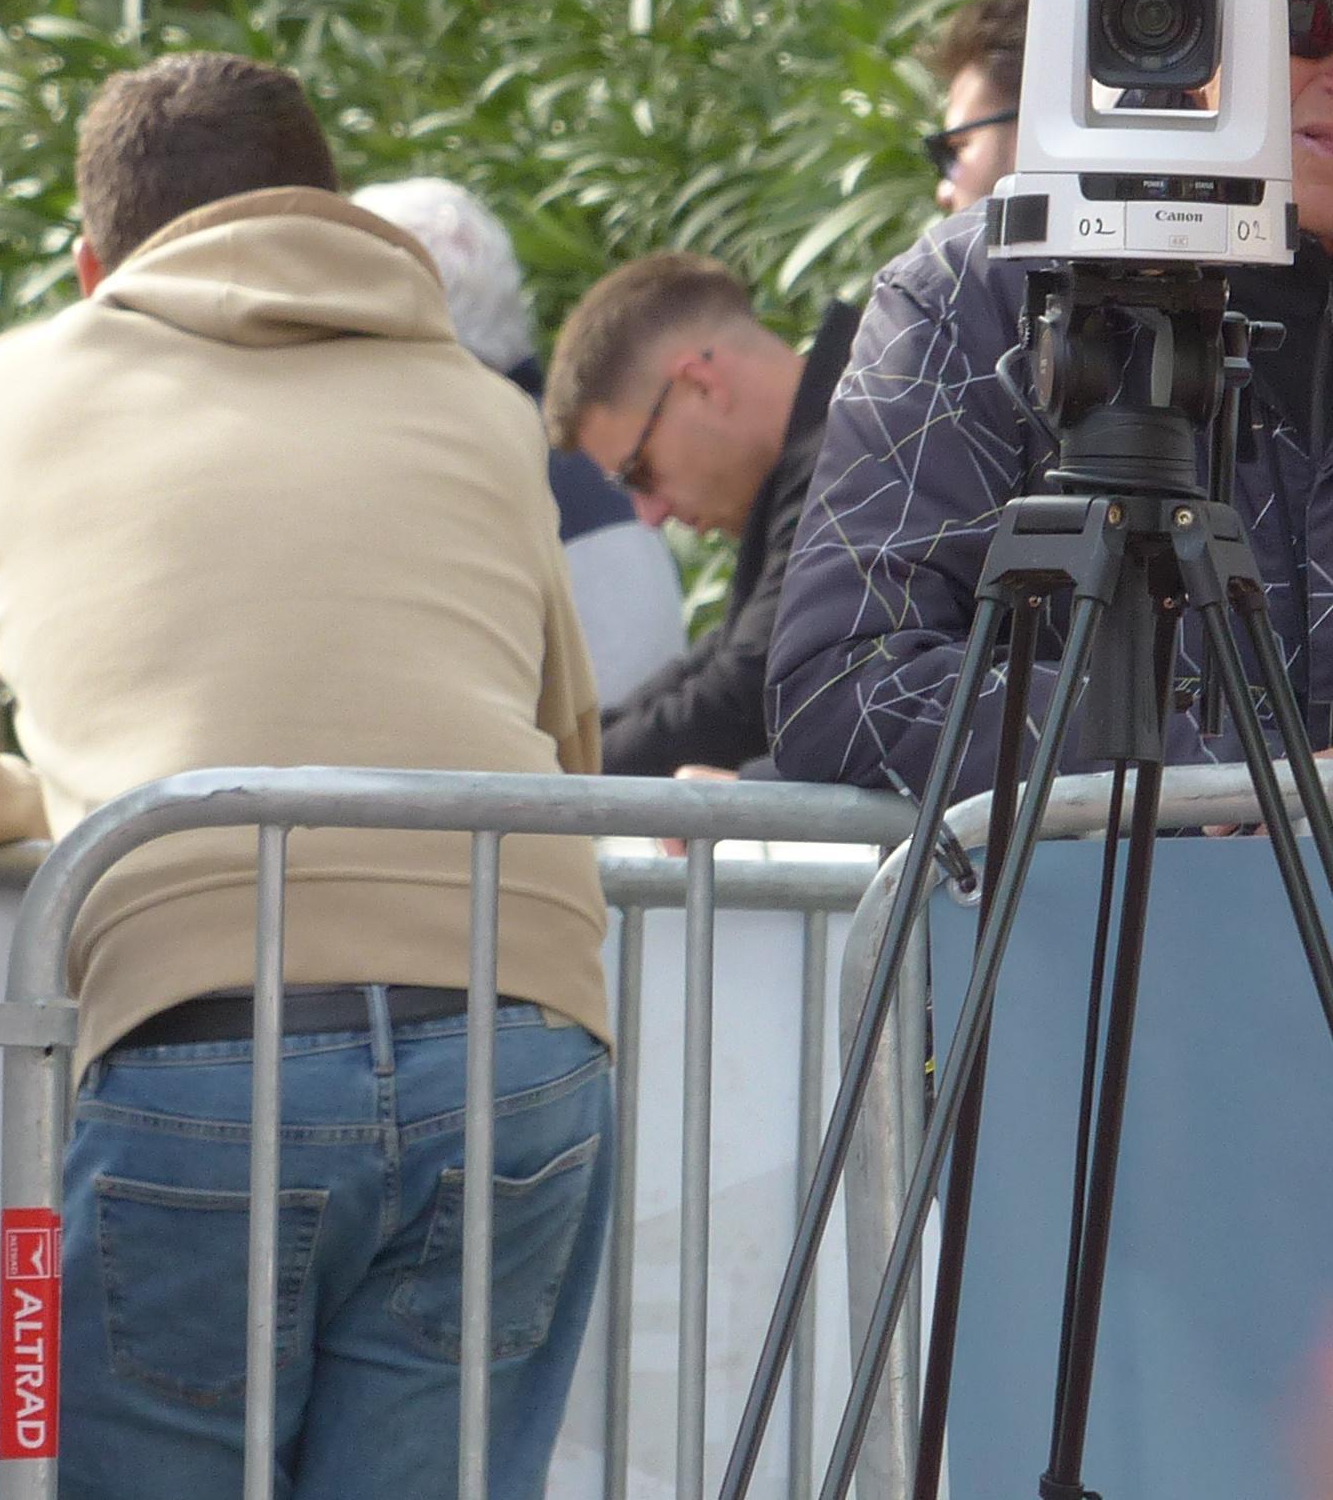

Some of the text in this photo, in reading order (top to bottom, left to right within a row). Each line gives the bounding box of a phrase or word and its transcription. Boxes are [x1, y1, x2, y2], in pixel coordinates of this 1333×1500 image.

[1154, 209, 1203, 223] Canon
[1079, 217, 1116, 236] 02
[1237, 219, 1267, 241] 02
[13, 1287, 46, 1450] ALTRAD
